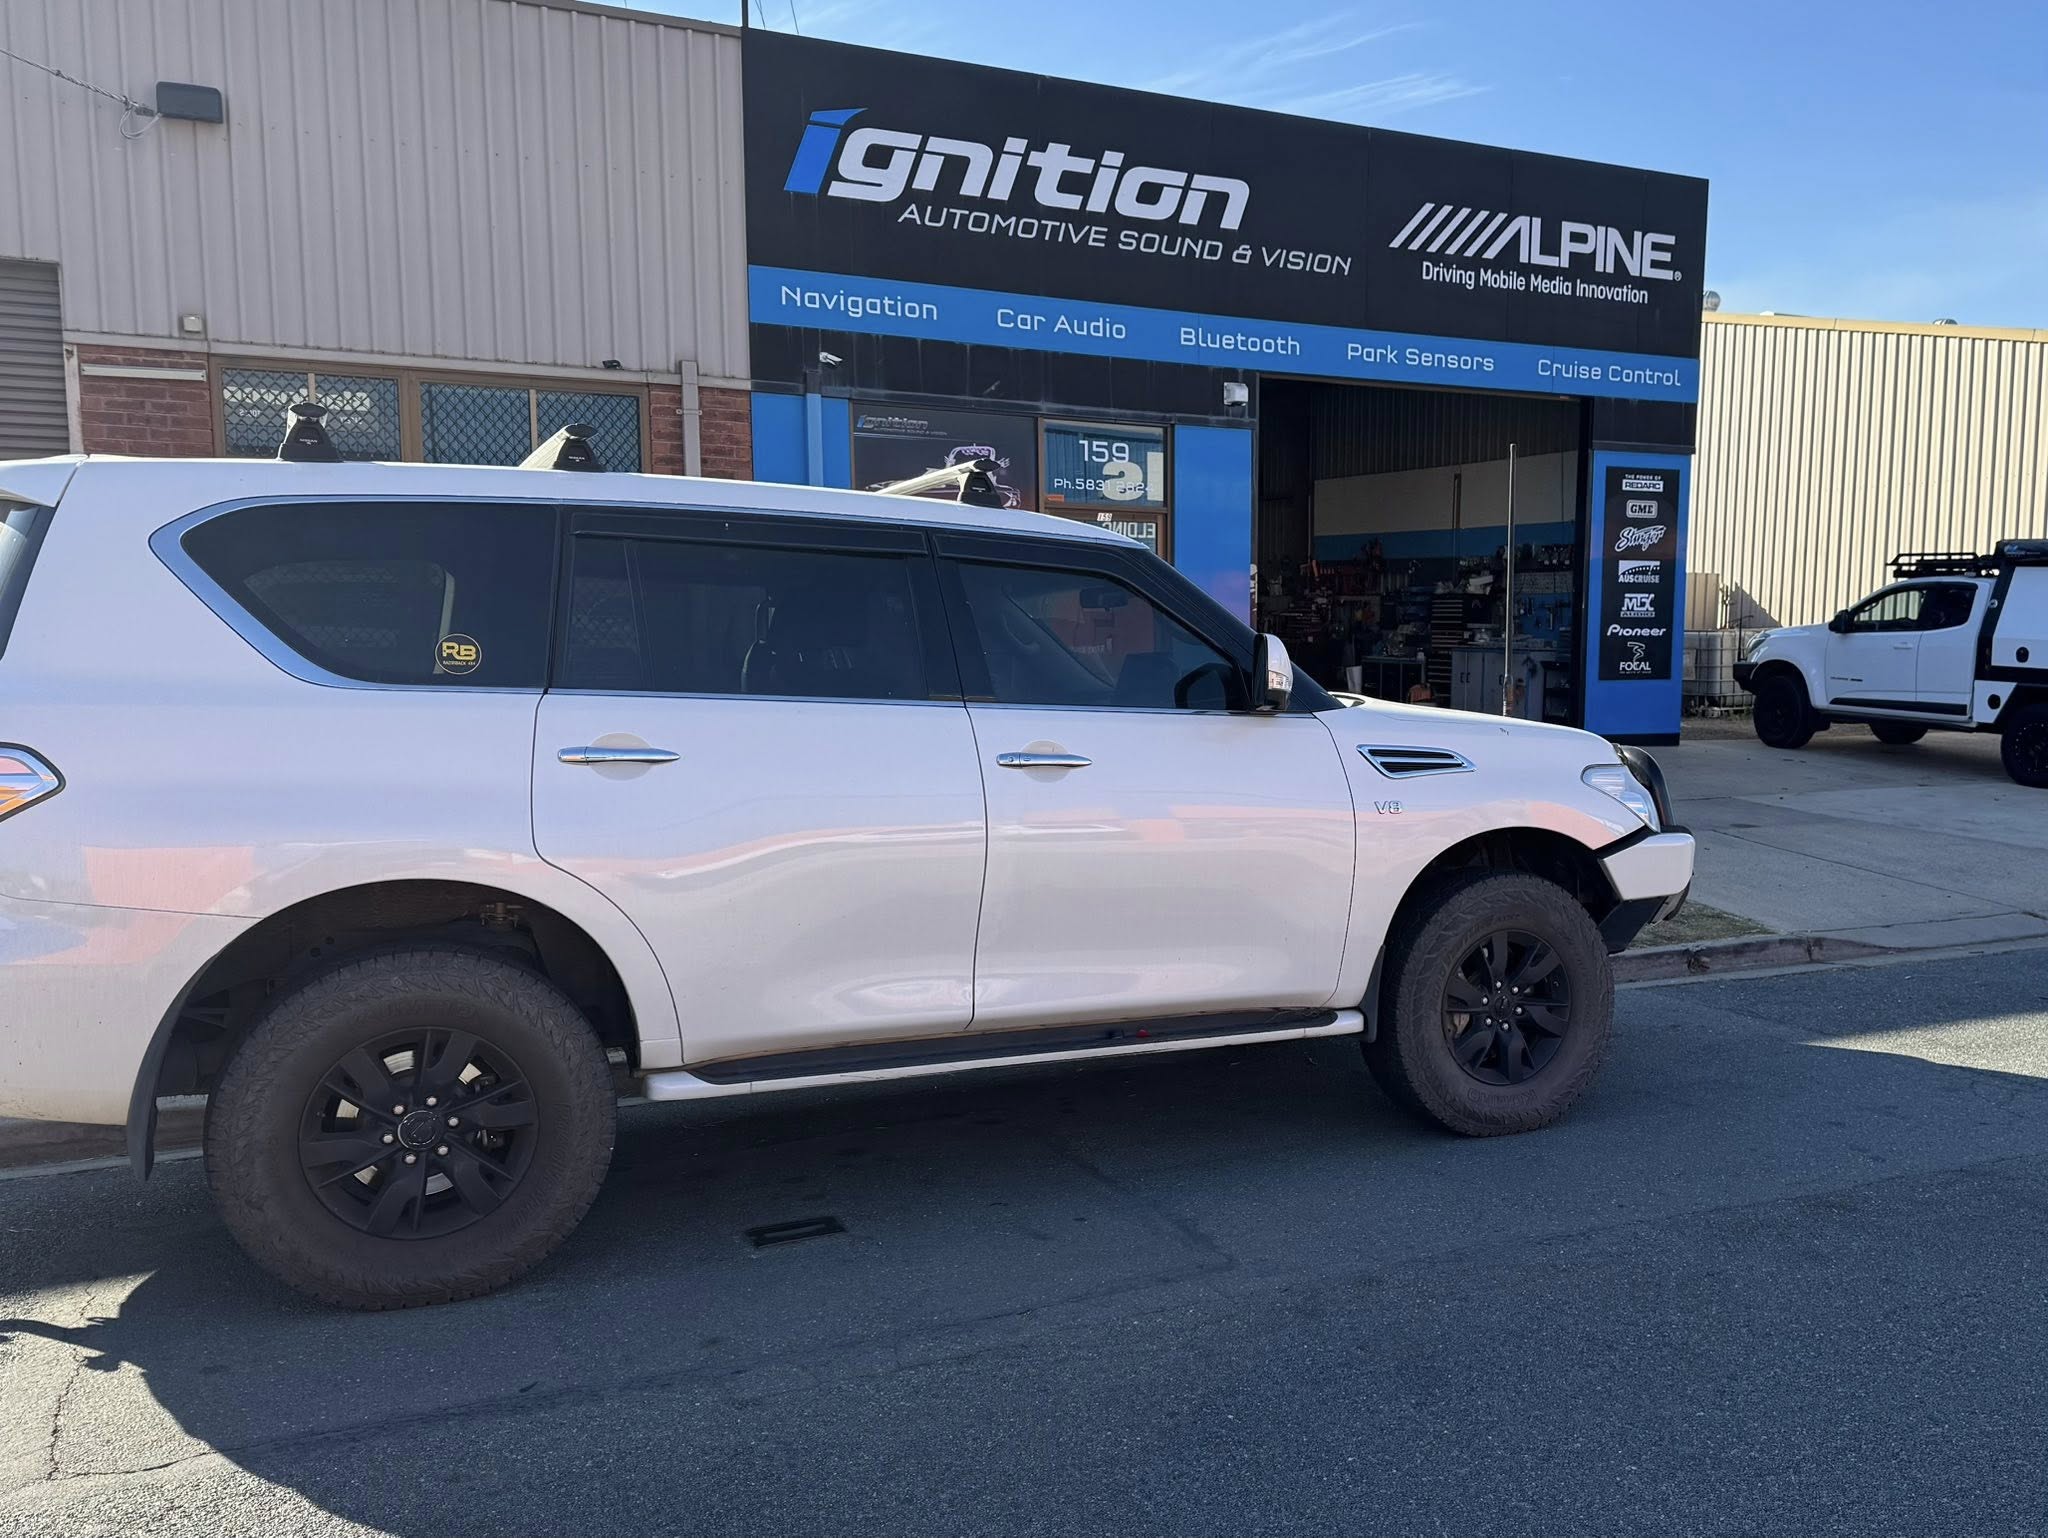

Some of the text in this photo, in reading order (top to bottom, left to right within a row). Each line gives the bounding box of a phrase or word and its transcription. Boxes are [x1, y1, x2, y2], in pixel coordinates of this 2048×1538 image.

[784, 107, 1250, 230] ignition
[898, 203, 1352, 275] AUTOMOTIVE SOUND & VISION
[1483, 214, 1676, 280] ALPINE
[1421, 261, 1649, 304] Driving Mobile Media Innovation
[781, 285, 938, 321] Navigation
[997, 308, 1126, 340] Car Audio
[1180, 327, 1300, 356] Bluetooth
[1347, 343, 1495, 371] Park Sensors
[1538, 359, 1681, 387] Cruise Control
[1079, 440, 1129, 463] 159
[1625, 481, 1661, 489] REDARC
[1630, 503, 1654, 514] GME
[1622, 593, 1655, 611] MTX
[1607, 624, 1666, 636] Pioneer
[442, 641, 477, 660] RB
[1619, 661, 1652, 671] FOCAL
[1374, 800, 1402, 814] V8
